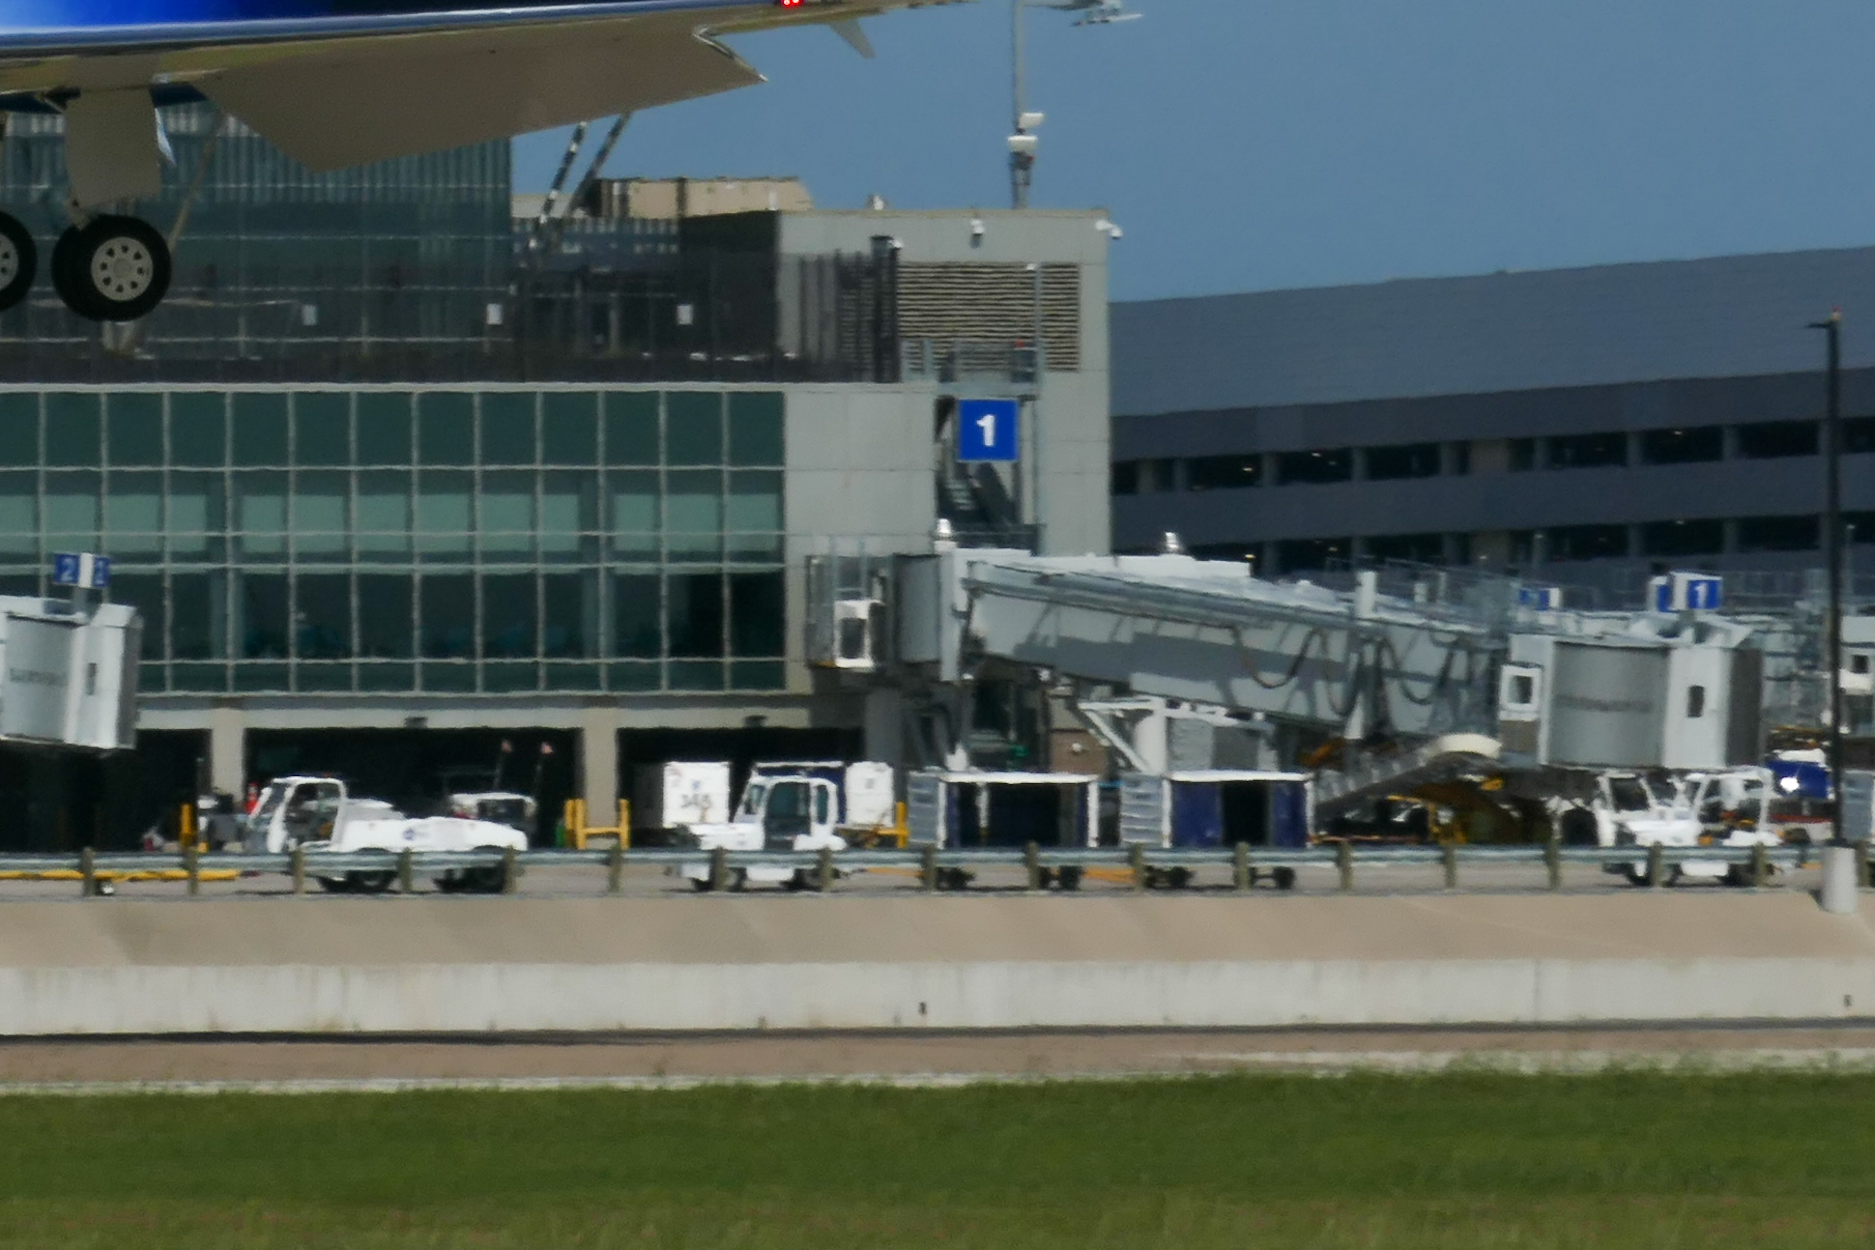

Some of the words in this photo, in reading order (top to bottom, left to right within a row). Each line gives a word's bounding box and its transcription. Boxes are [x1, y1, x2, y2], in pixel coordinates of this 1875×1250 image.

[976, 414, 996, 447] 1
[61, 556, 76, 581] 2
[1694, 582, 1708, 609] 1
